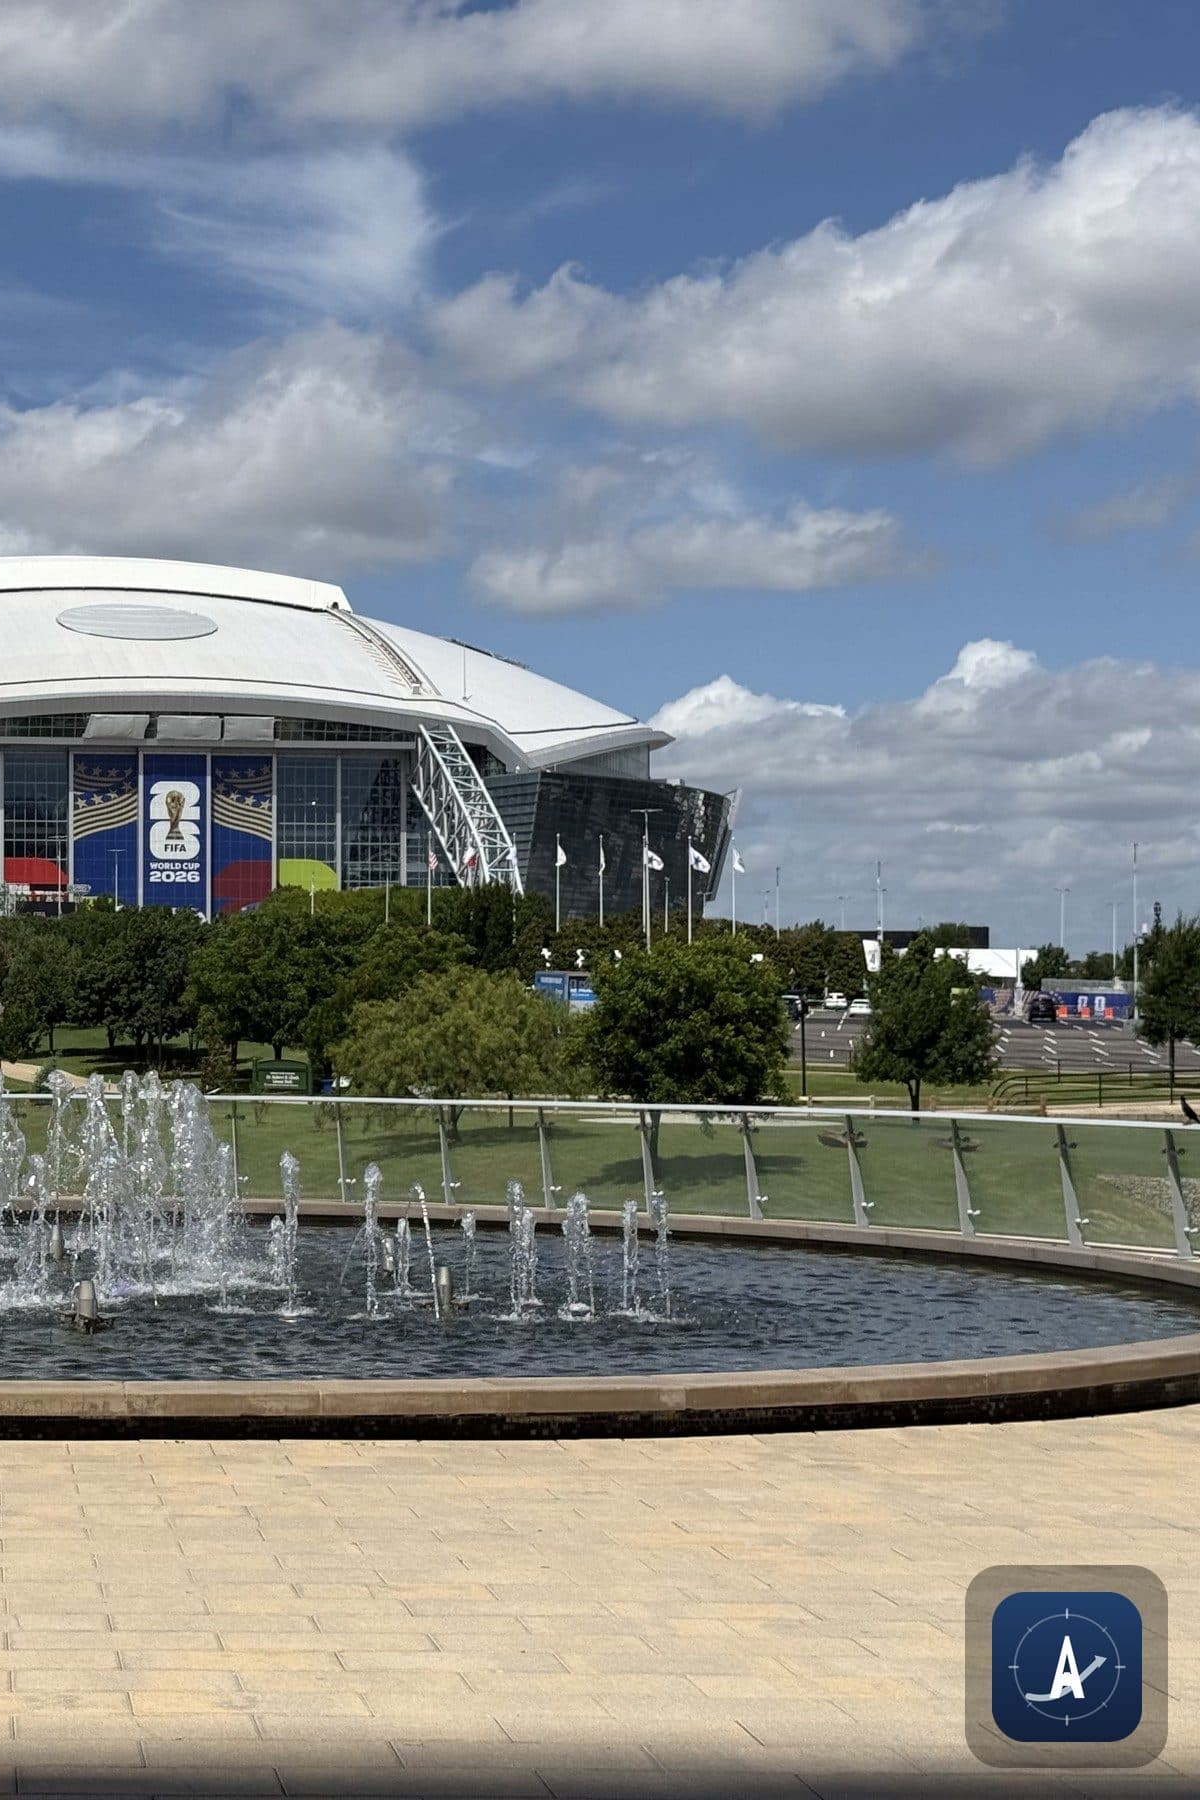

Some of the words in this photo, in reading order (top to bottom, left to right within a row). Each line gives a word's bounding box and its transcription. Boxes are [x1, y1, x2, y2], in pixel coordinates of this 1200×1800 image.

[164, 844, 187, 852] FIFA
[149, 862, 181, 870] WORLD
[182, 862, 201, 870] CUP
[149, 871, 201, 883] 2026
